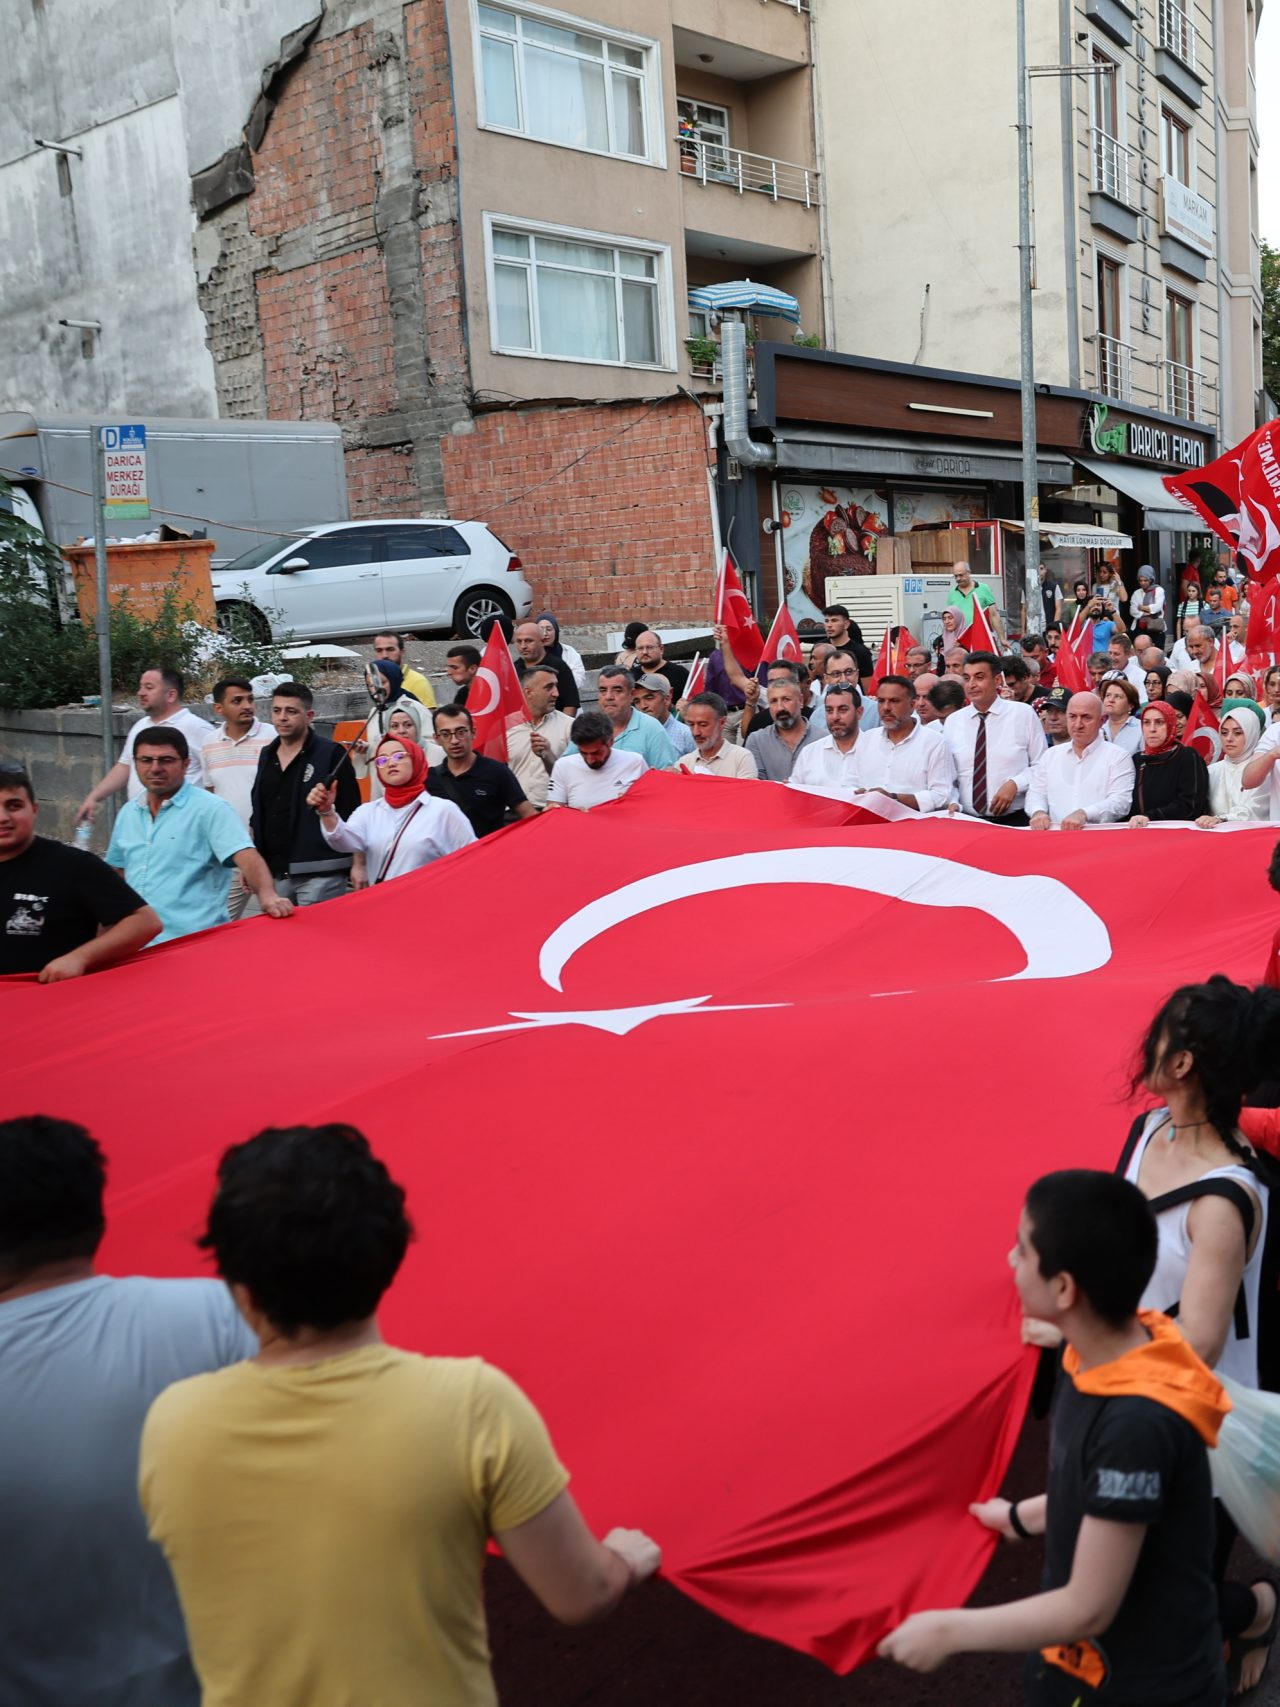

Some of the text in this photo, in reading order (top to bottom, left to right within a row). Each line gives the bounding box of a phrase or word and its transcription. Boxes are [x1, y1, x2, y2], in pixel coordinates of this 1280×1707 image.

[105, 428, 118, 449] D
[1130, 422, 1169, 461] DARICA
[1172, 434, 1205, 467] FIRINI
[107, 455, 142, 467] DARICA
[936, 458, 971, 475] DARICA
[106, 470, 144, 482] MERKEZ
[110, 481, 141, 496] DURAĞI
